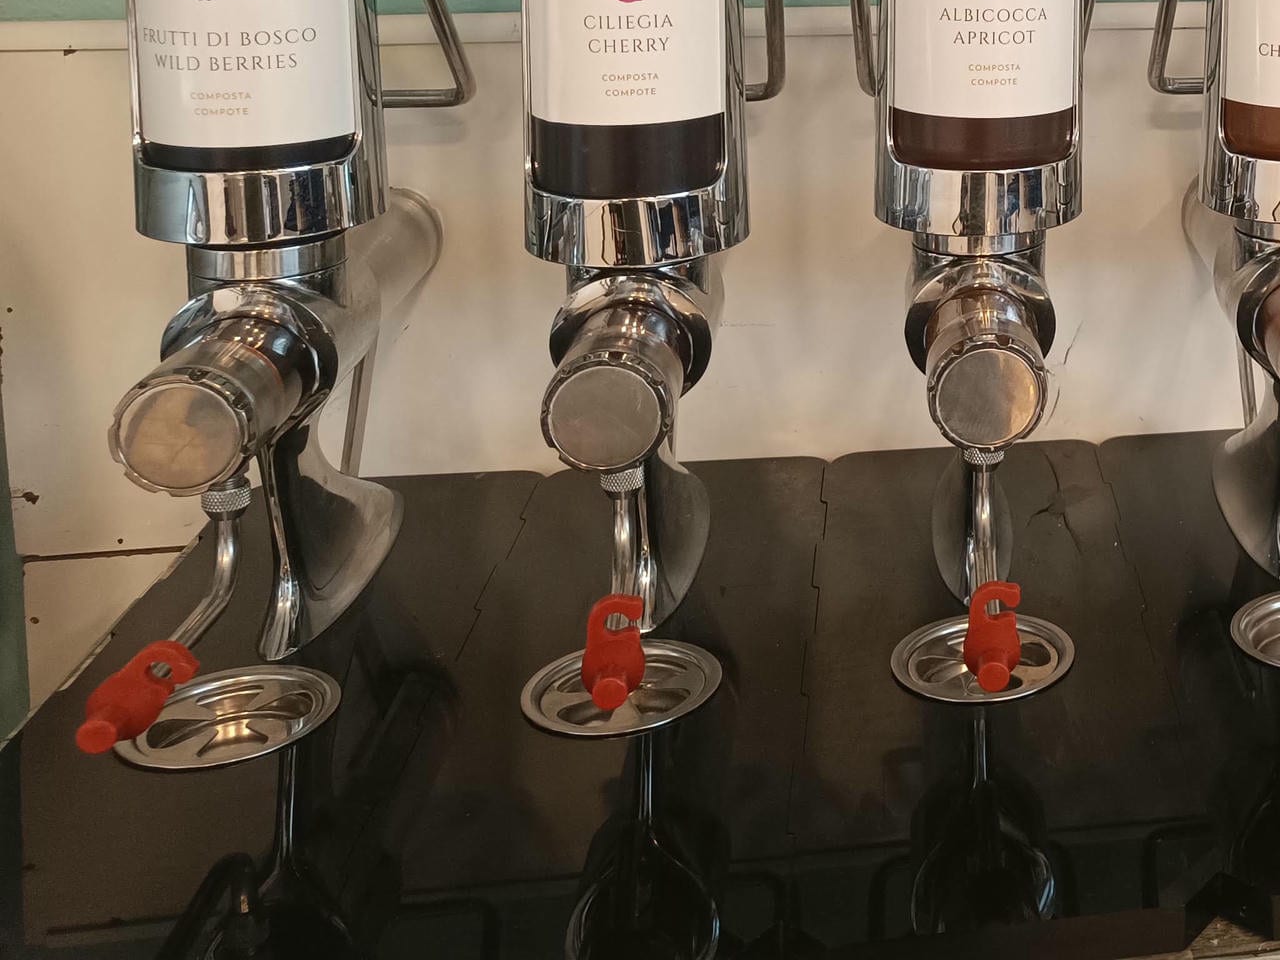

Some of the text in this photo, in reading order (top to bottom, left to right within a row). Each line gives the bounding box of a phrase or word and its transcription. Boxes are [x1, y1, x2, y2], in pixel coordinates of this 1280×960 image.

[939, 7, 1047, 22] ALBICOCCA
[583, 14, 673, 29] CILIEGIA
[143, 27, 317, 46] FRUTTI DI BOSCO
[953, 30, 1036, 45] APRICOT
[588, 37, 670, 53] CHERRY
[155, 53, 298, 71] WILD BERRIES
[968, 64, 1021, 72] COMPOSTA
[602, 73, 659, 82] COMPOSTA
[971, 78, 1017, 86] COMPOTE
[190, 92, 252, 100] COMPOSTA
[605, 88, 657, 97] COMPOTE
[194, 107, 249, 116] COMPOTE
